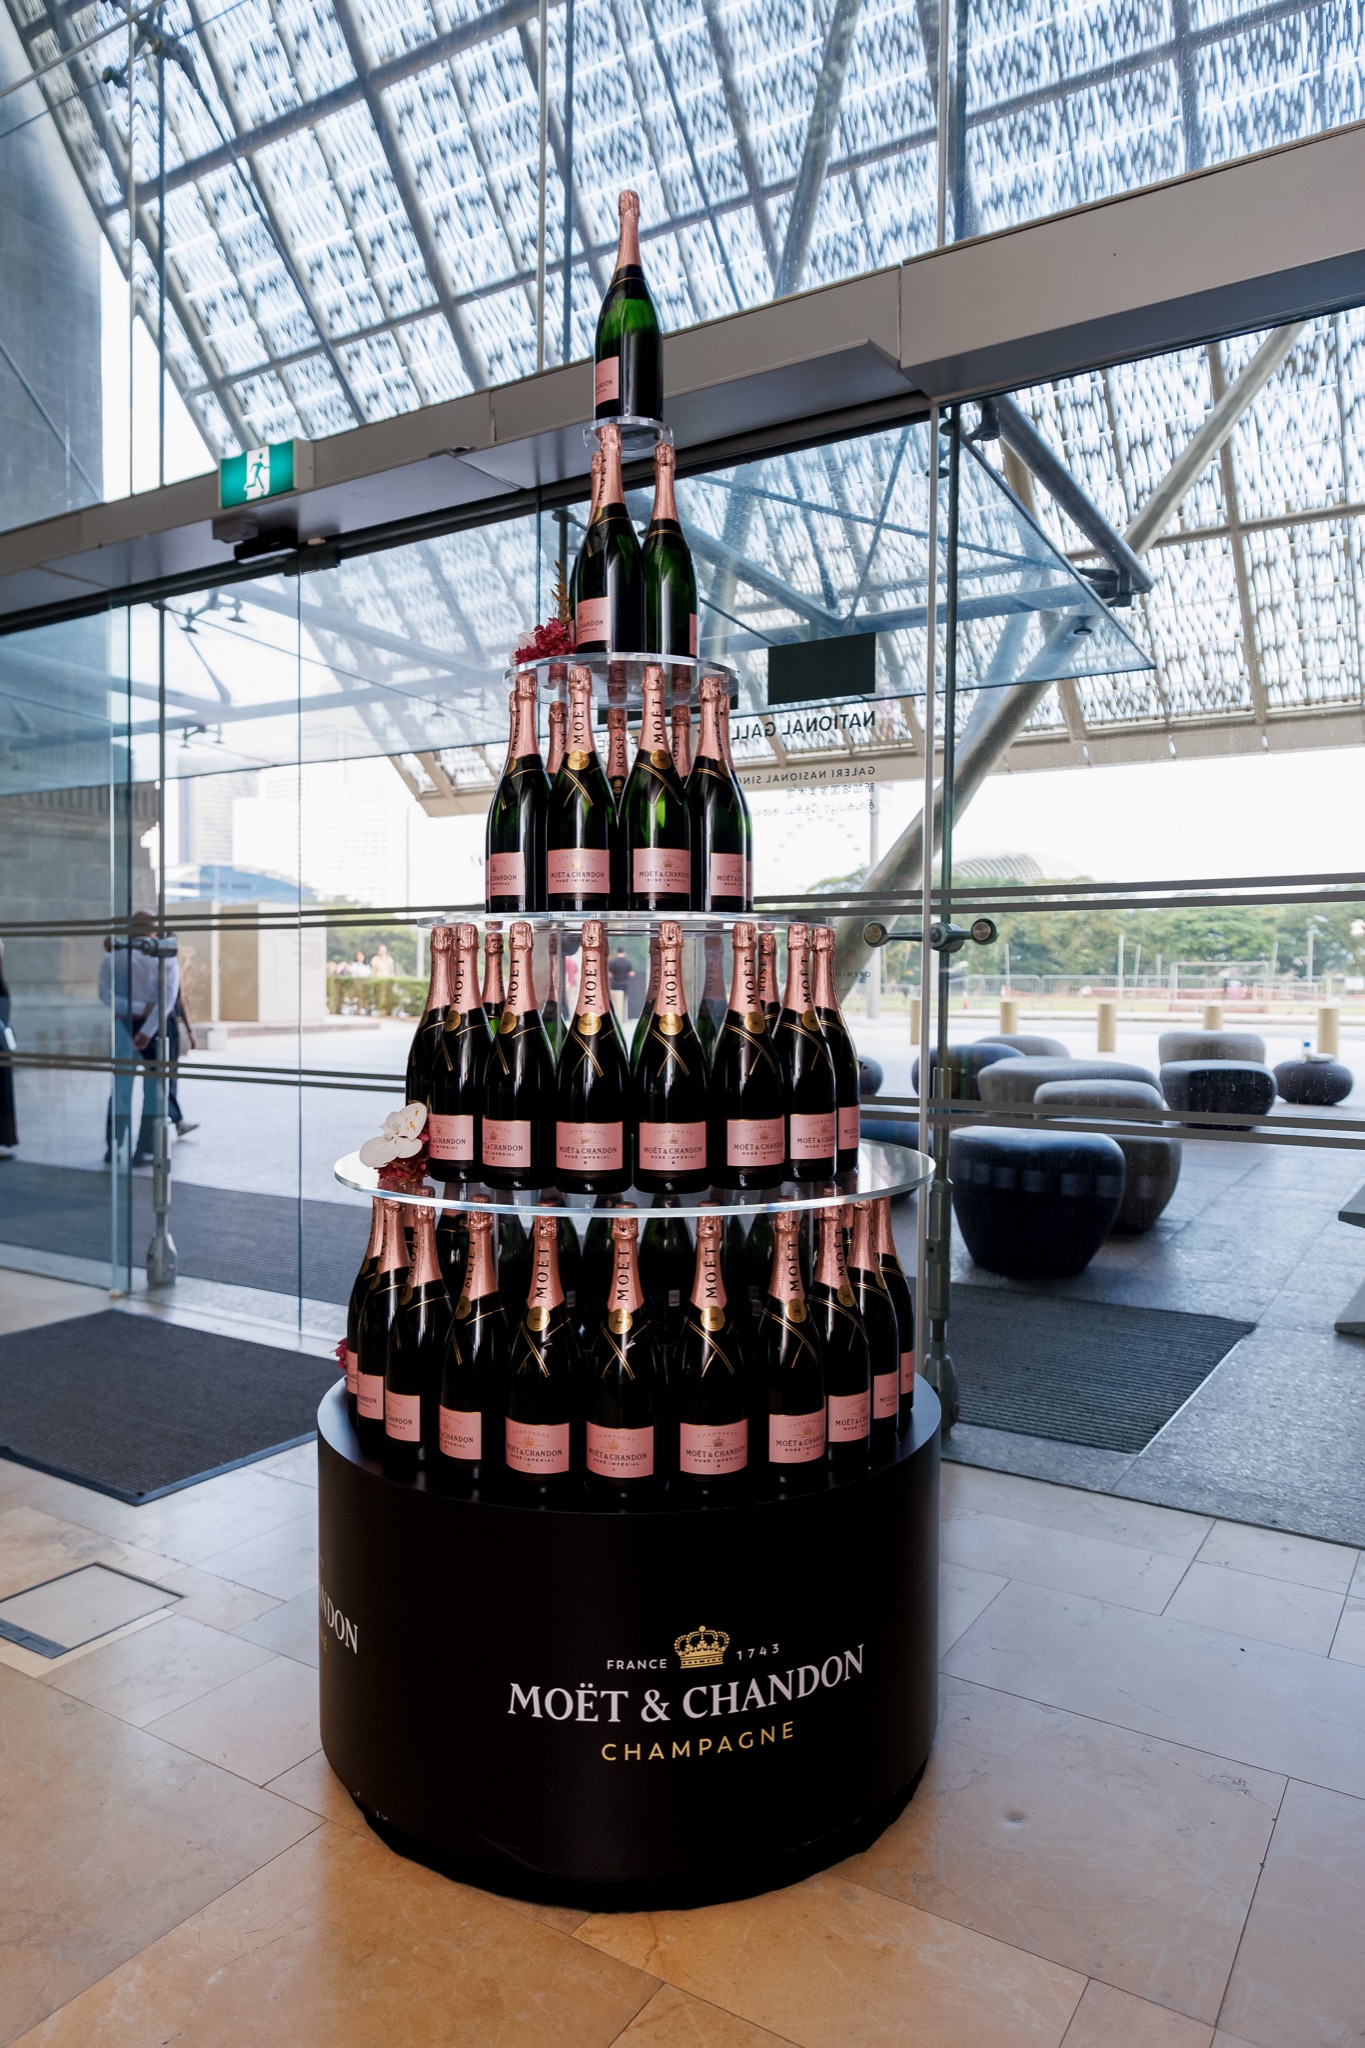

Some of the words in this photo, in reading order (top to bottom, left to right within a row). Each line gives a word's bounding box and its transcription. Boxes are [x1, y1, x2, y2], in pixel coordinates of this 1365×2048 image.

[571, 870, 605, 879] CHANDON
[436, 1137, 466, 1145] CHANDON
[796, 1136, 816, 1144] MOËT
[491, 1143, 524, 1152] CHANDON
[559, 1145, 575, 1154] MOËT
[581, 1146, 617, 1155] CHANDON
[643, 1145, 663, 1154] MOËT
[668, 1146, 703, 1155] CHANDON
[733, 1142, 754, 1151] MOËT
[703, 1246, 718, 1299] MOËT
[835, 1417, 855, 1427] MOËT
[444, 1431, 474, 1443] CHANDON
[775, 1438, 797, 1447] MOËT
[525, 1448, 563, 1457] CHANDON
[588, 1447, 603, 1459] MOËT
[609, 1452, 648, 1461] CHANDON
[685, 1447, 707, 1458] MOËT
[714, 1445, 746, 1458] CHANDON
[606, 1657, 668, 1670] FRANCE
[736, 1643, 780, 1661] 1743
[507, 1682, 629, 1723] MOËT
[640, 1689, 671, 1723] &
[682, 1643, 865, 1719] CHANDON
[601, 1720, 795, 1761] CHAMPAGNE
